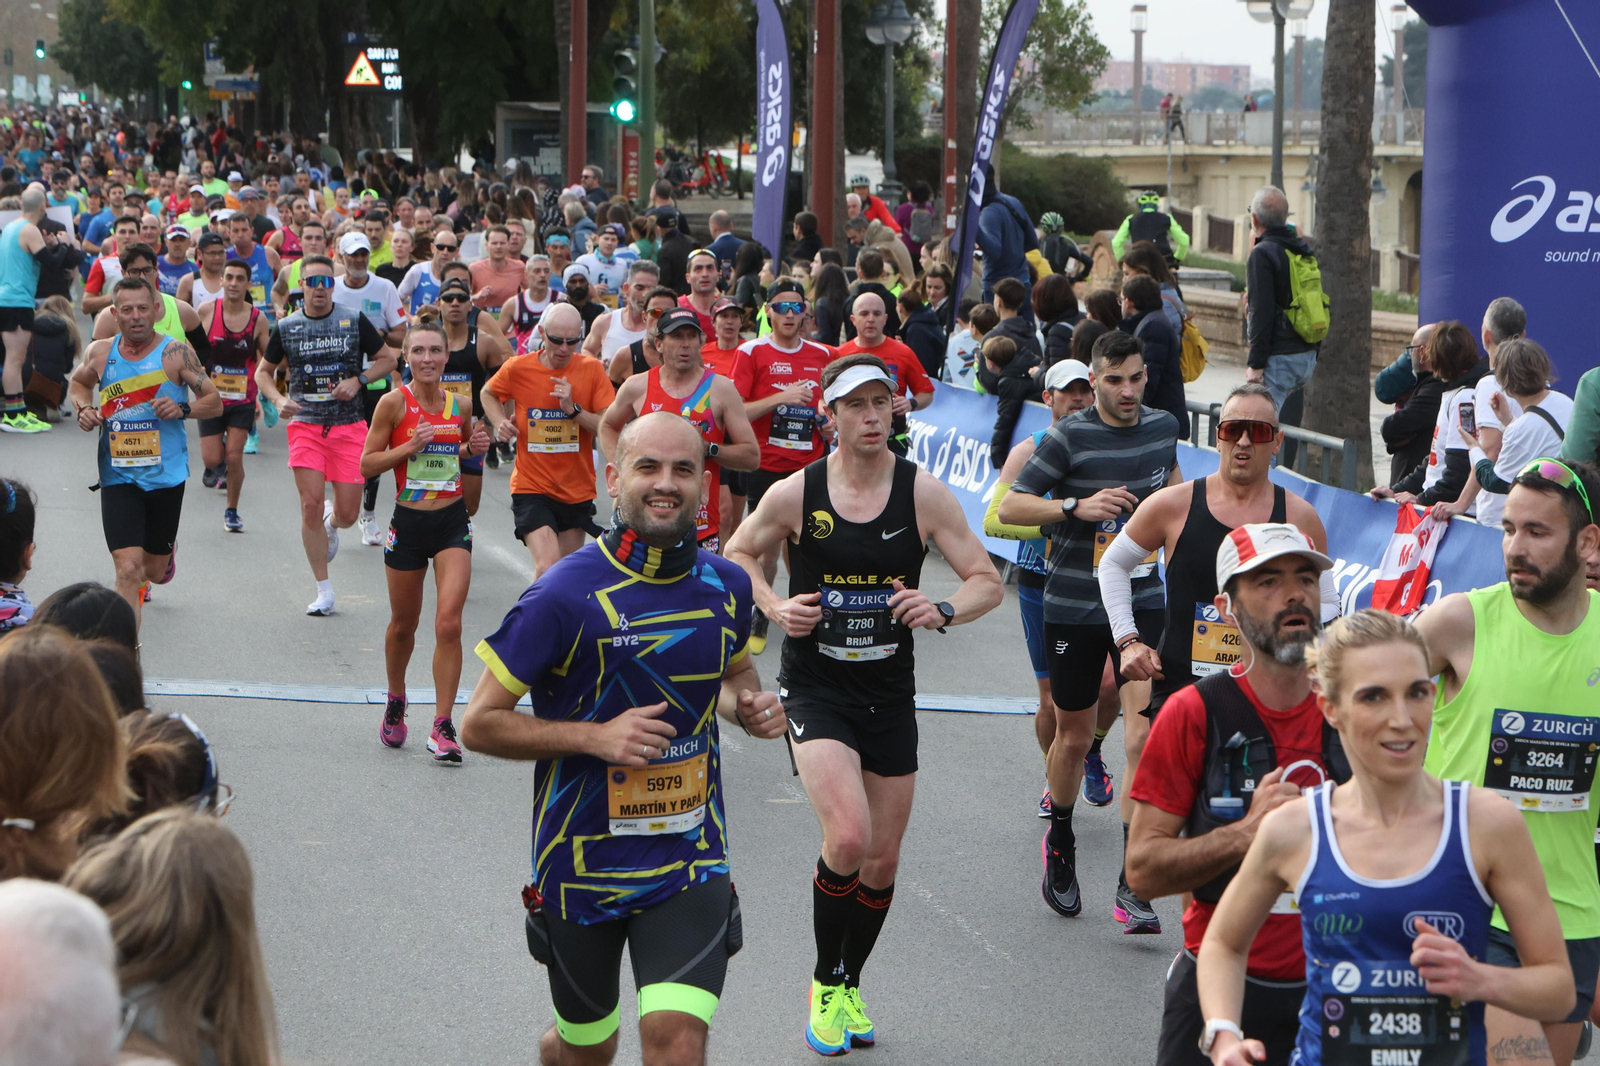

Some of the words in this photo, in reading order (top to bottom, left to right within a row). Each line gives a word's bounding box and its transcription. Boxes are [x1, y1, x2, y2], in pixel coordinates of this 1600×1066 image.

[1544, 248, 1590, 262] sound
[300, 340, 314, 350] Las
[316, 336, 342, 348] Tablas
[790, 408, 814, 416] ZURICH
[787, 421, 803, 430] 3280
[428, 444, 455, 452] ZURICH
[824, 574, 878, 584] EAGLE
[849, 594, 894, 605] ZURICH
[847, 618, 874, 630] 2780
[612, 635, 640, 647] BY2
[846, 636, 873, 646] BRIAN
[1532, 719, 1594, 736] ZURICH
[1526, 751, 1564, 768] 3264
[647, 775, 682, 792] 5979
[1510, 776, 1543, 790] PACO
[1546, 779, 1574, 791] RUIZ
[620, 800, 666, 816] MARTÍN
[670, 801, 677, 812] Y
[681, 791, 701, 810] PAPÁ
[1369, 1013, 1422, 1034] 2438
[1371, 1049, 1422, 1066] EMILY
